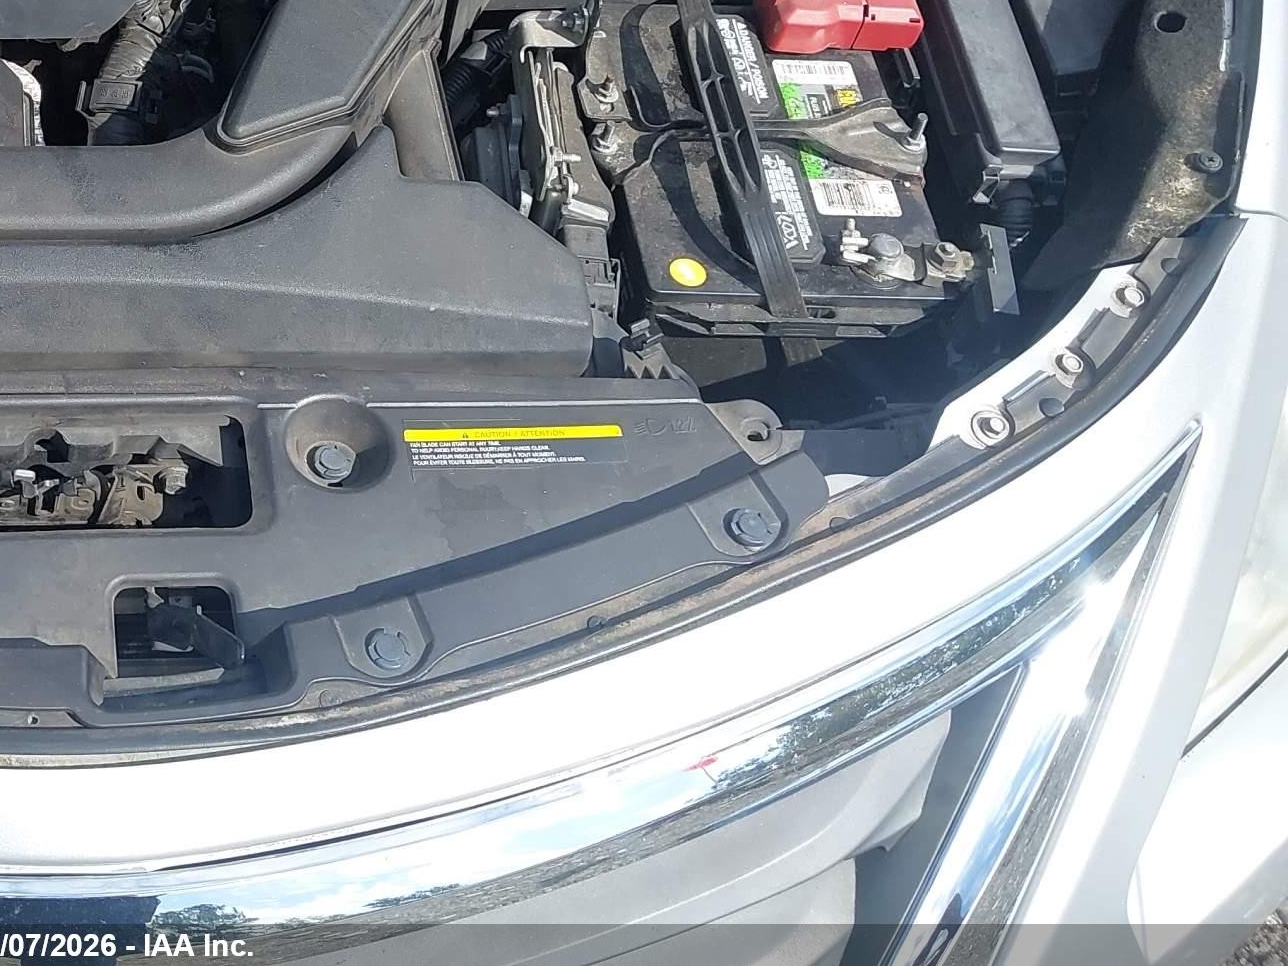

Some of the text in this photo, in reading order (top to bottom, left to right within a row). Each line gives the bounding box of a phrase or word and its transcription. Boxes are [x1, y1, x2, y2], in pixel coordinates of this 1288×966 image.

[739, 29, 758, 63] DANGER
[751, 68, 770, 99] POISON
[474, 430, 511, 438] CAUTION
[520, 429, 565, 437] ATTENTION
